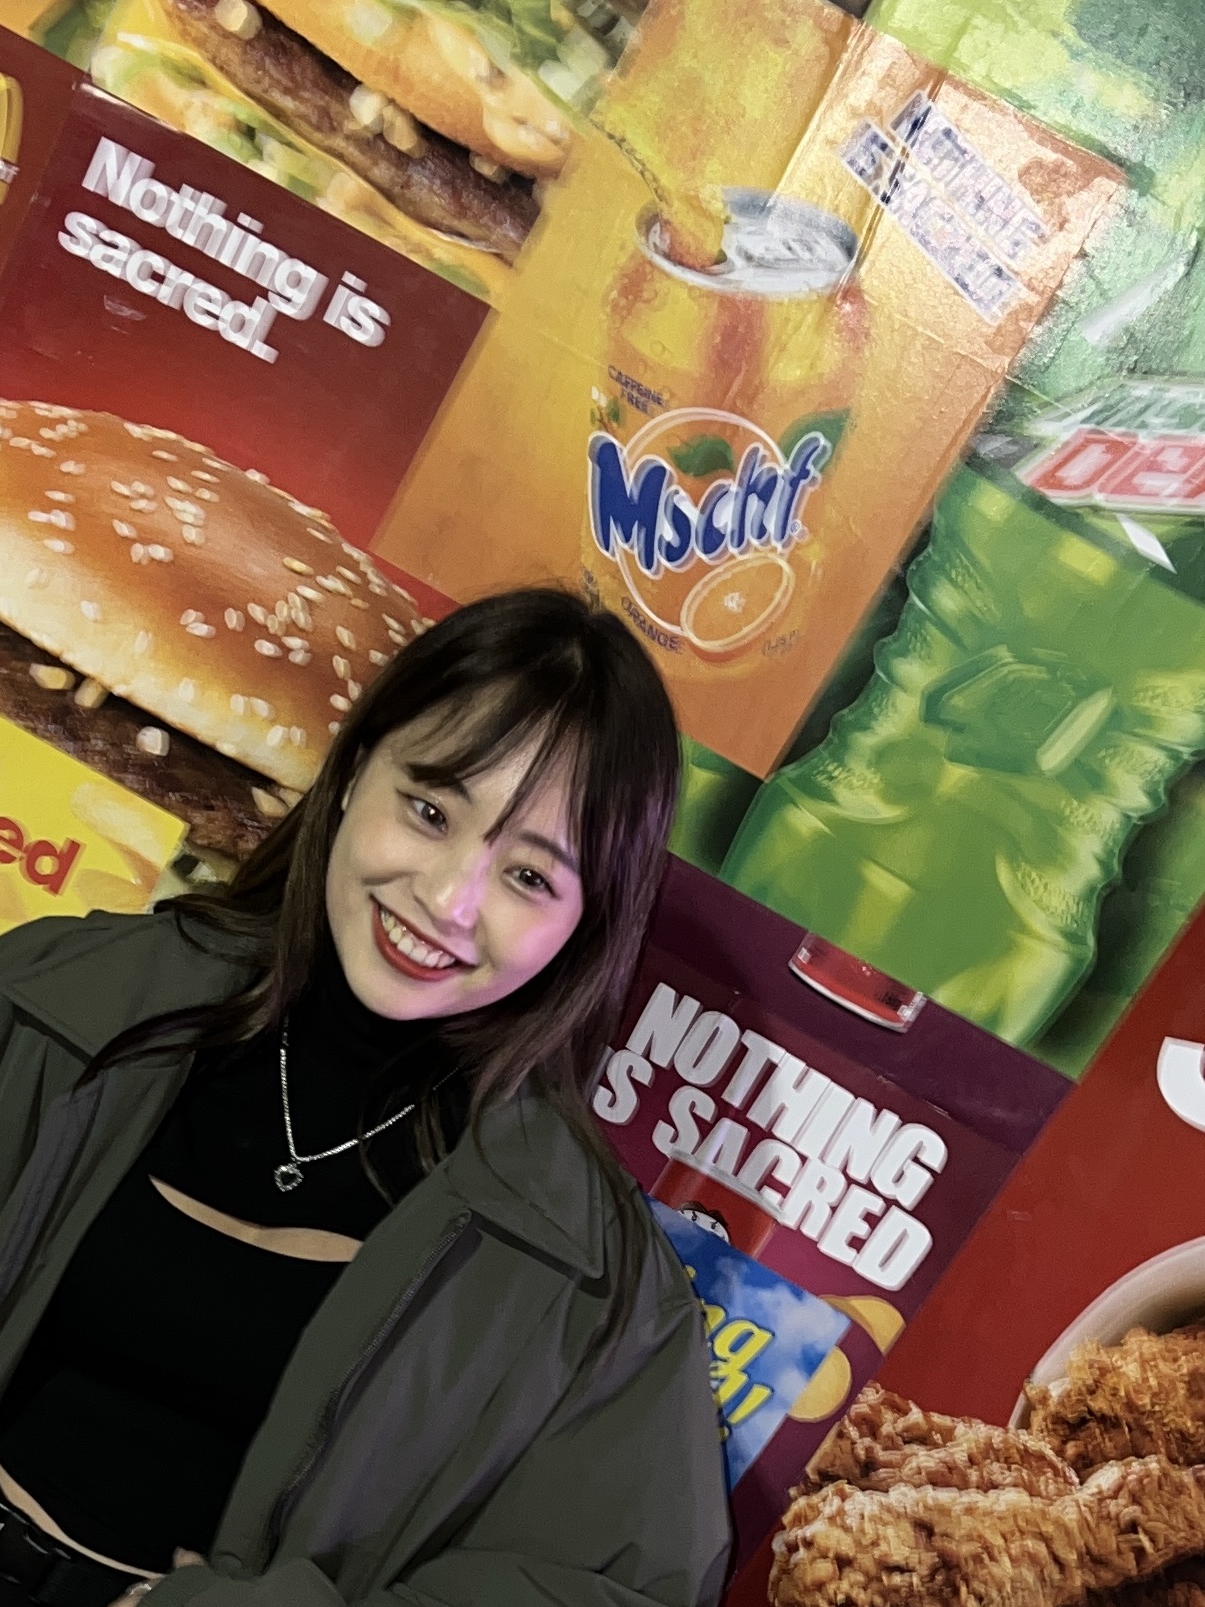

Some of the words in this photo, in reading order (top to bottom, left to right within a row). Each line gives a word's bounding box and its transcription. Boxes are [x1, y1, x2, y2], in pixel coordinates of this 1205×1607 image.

[58, 212, 279, 364] sacred.
[81, 136, 330, 321] Nothing
[323, 270, 391, 347] is
[590, 432, 831, 580] Mschf
[593, 1047, 655, 1125] S
[652, 1086, 933, 1291] SACRED
[626, 982, 948, 1211] NOTHING
